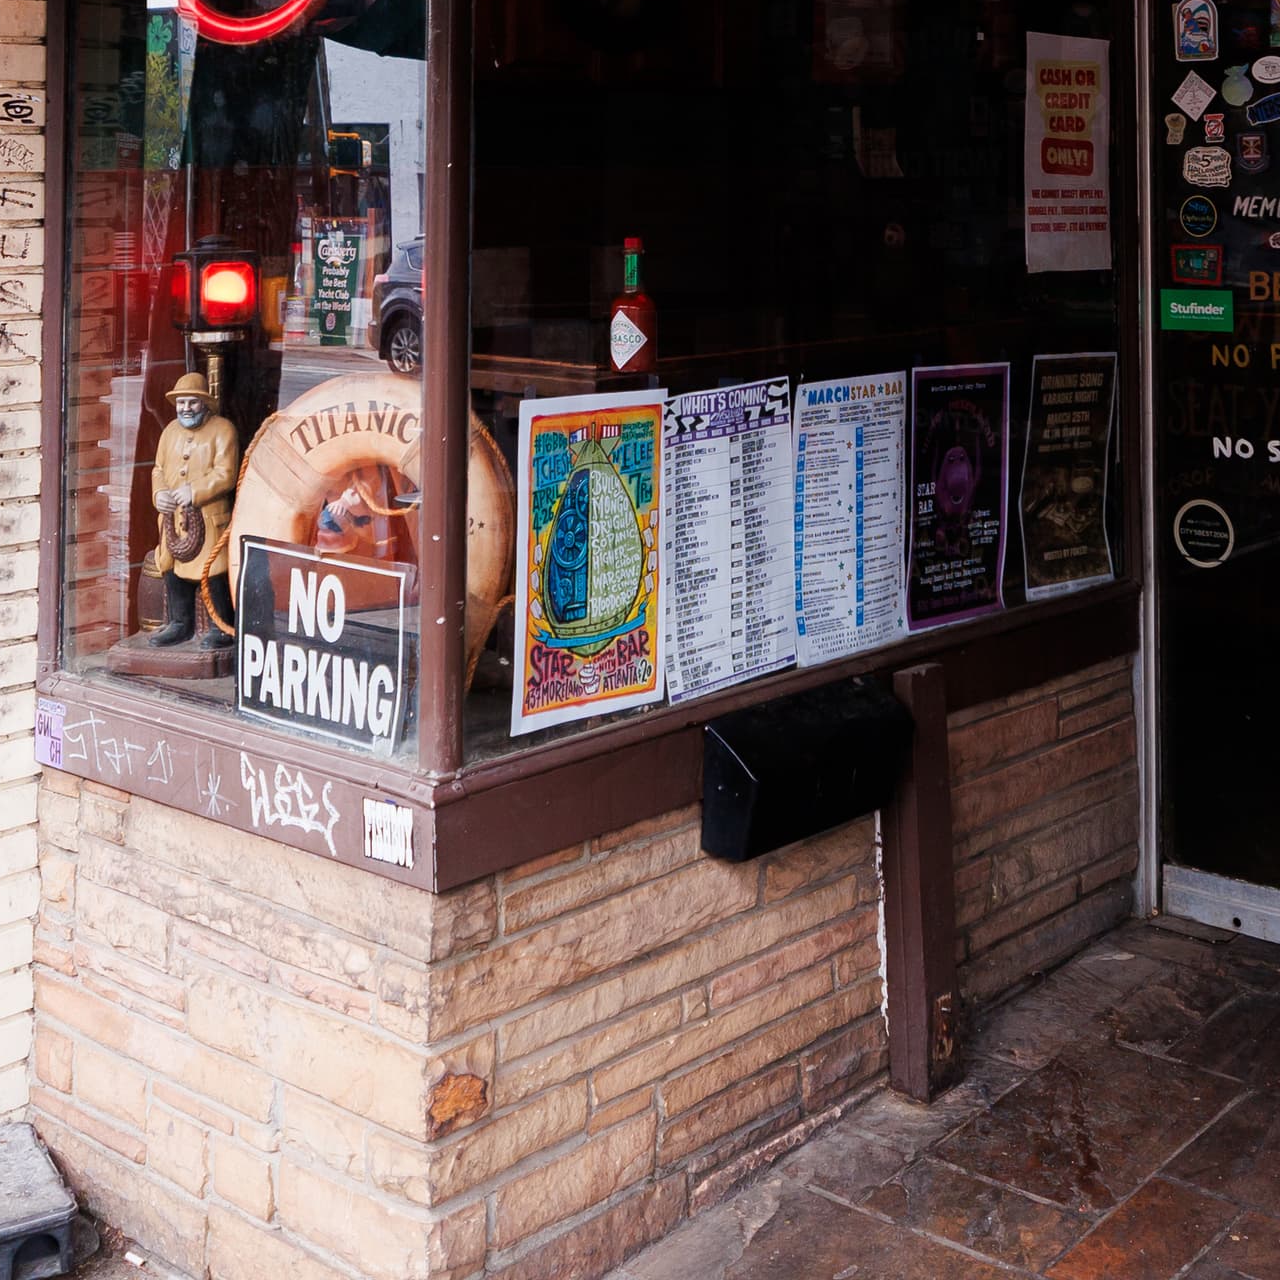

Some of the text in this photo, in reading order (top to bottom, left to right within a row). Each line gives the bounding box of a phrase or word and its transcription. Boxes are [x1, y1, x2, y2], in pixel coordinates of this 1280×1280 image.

[1039, 68, 1096, 87] CASH OR
[1045, 92, 1090, 110] CREDIT
[1049, 116, 1086, 133] CARD
[1046, 147, 1088, 167] ONLY!
[1170, 301, 1225, 315] Stufinder
[1211, 343, 1251, 367] NO
[1079, 372, 1104, 388] SONG
[681, 385, 767, 416] WHAT'S COMING
[808, 385, 850, 406] MARCH
[850, 383, 876, 401] STAR
[289, 399, 419, 455] TITANIC
[1213, 436, 1254, 459] NO
[917, 482, 936, 497] STAR
[918, 499, 934, 513] BAR
[288, 566, 346, 644] NO
[528, 629, 651, 687] STAR BAR
[242, 633, 396, 739] PARKING
